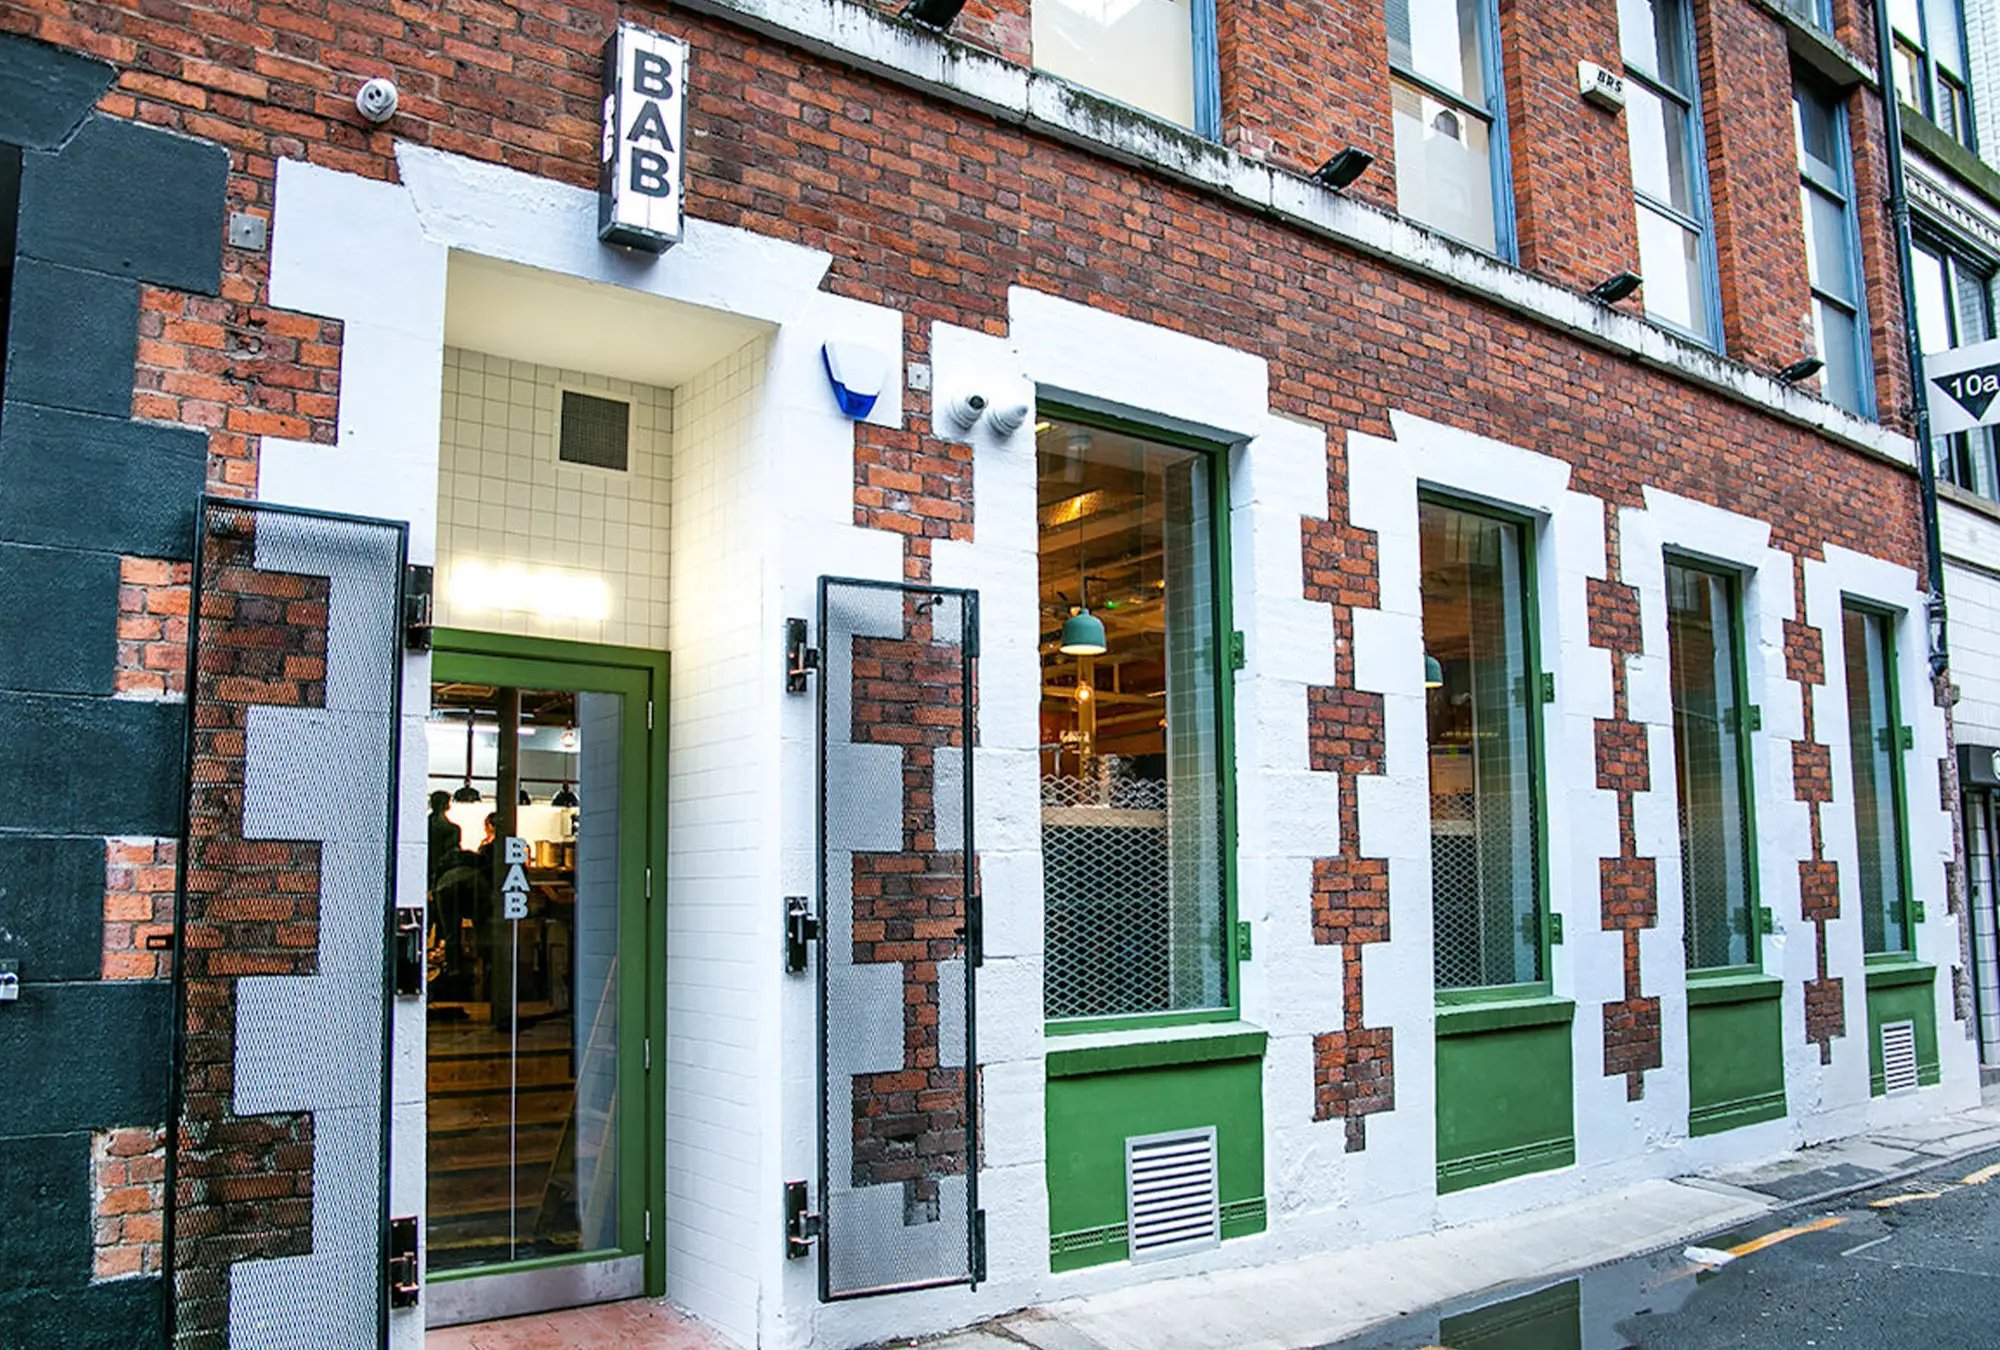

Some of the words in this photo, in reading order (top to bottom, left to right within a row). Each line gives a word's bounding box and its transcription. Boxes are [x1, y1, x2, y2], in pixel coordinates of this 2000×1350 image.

[626, 48, 675, 198] BAB
[1951, 374, 2000, 399] 10a
[501, 836, 530, 919] BAB
